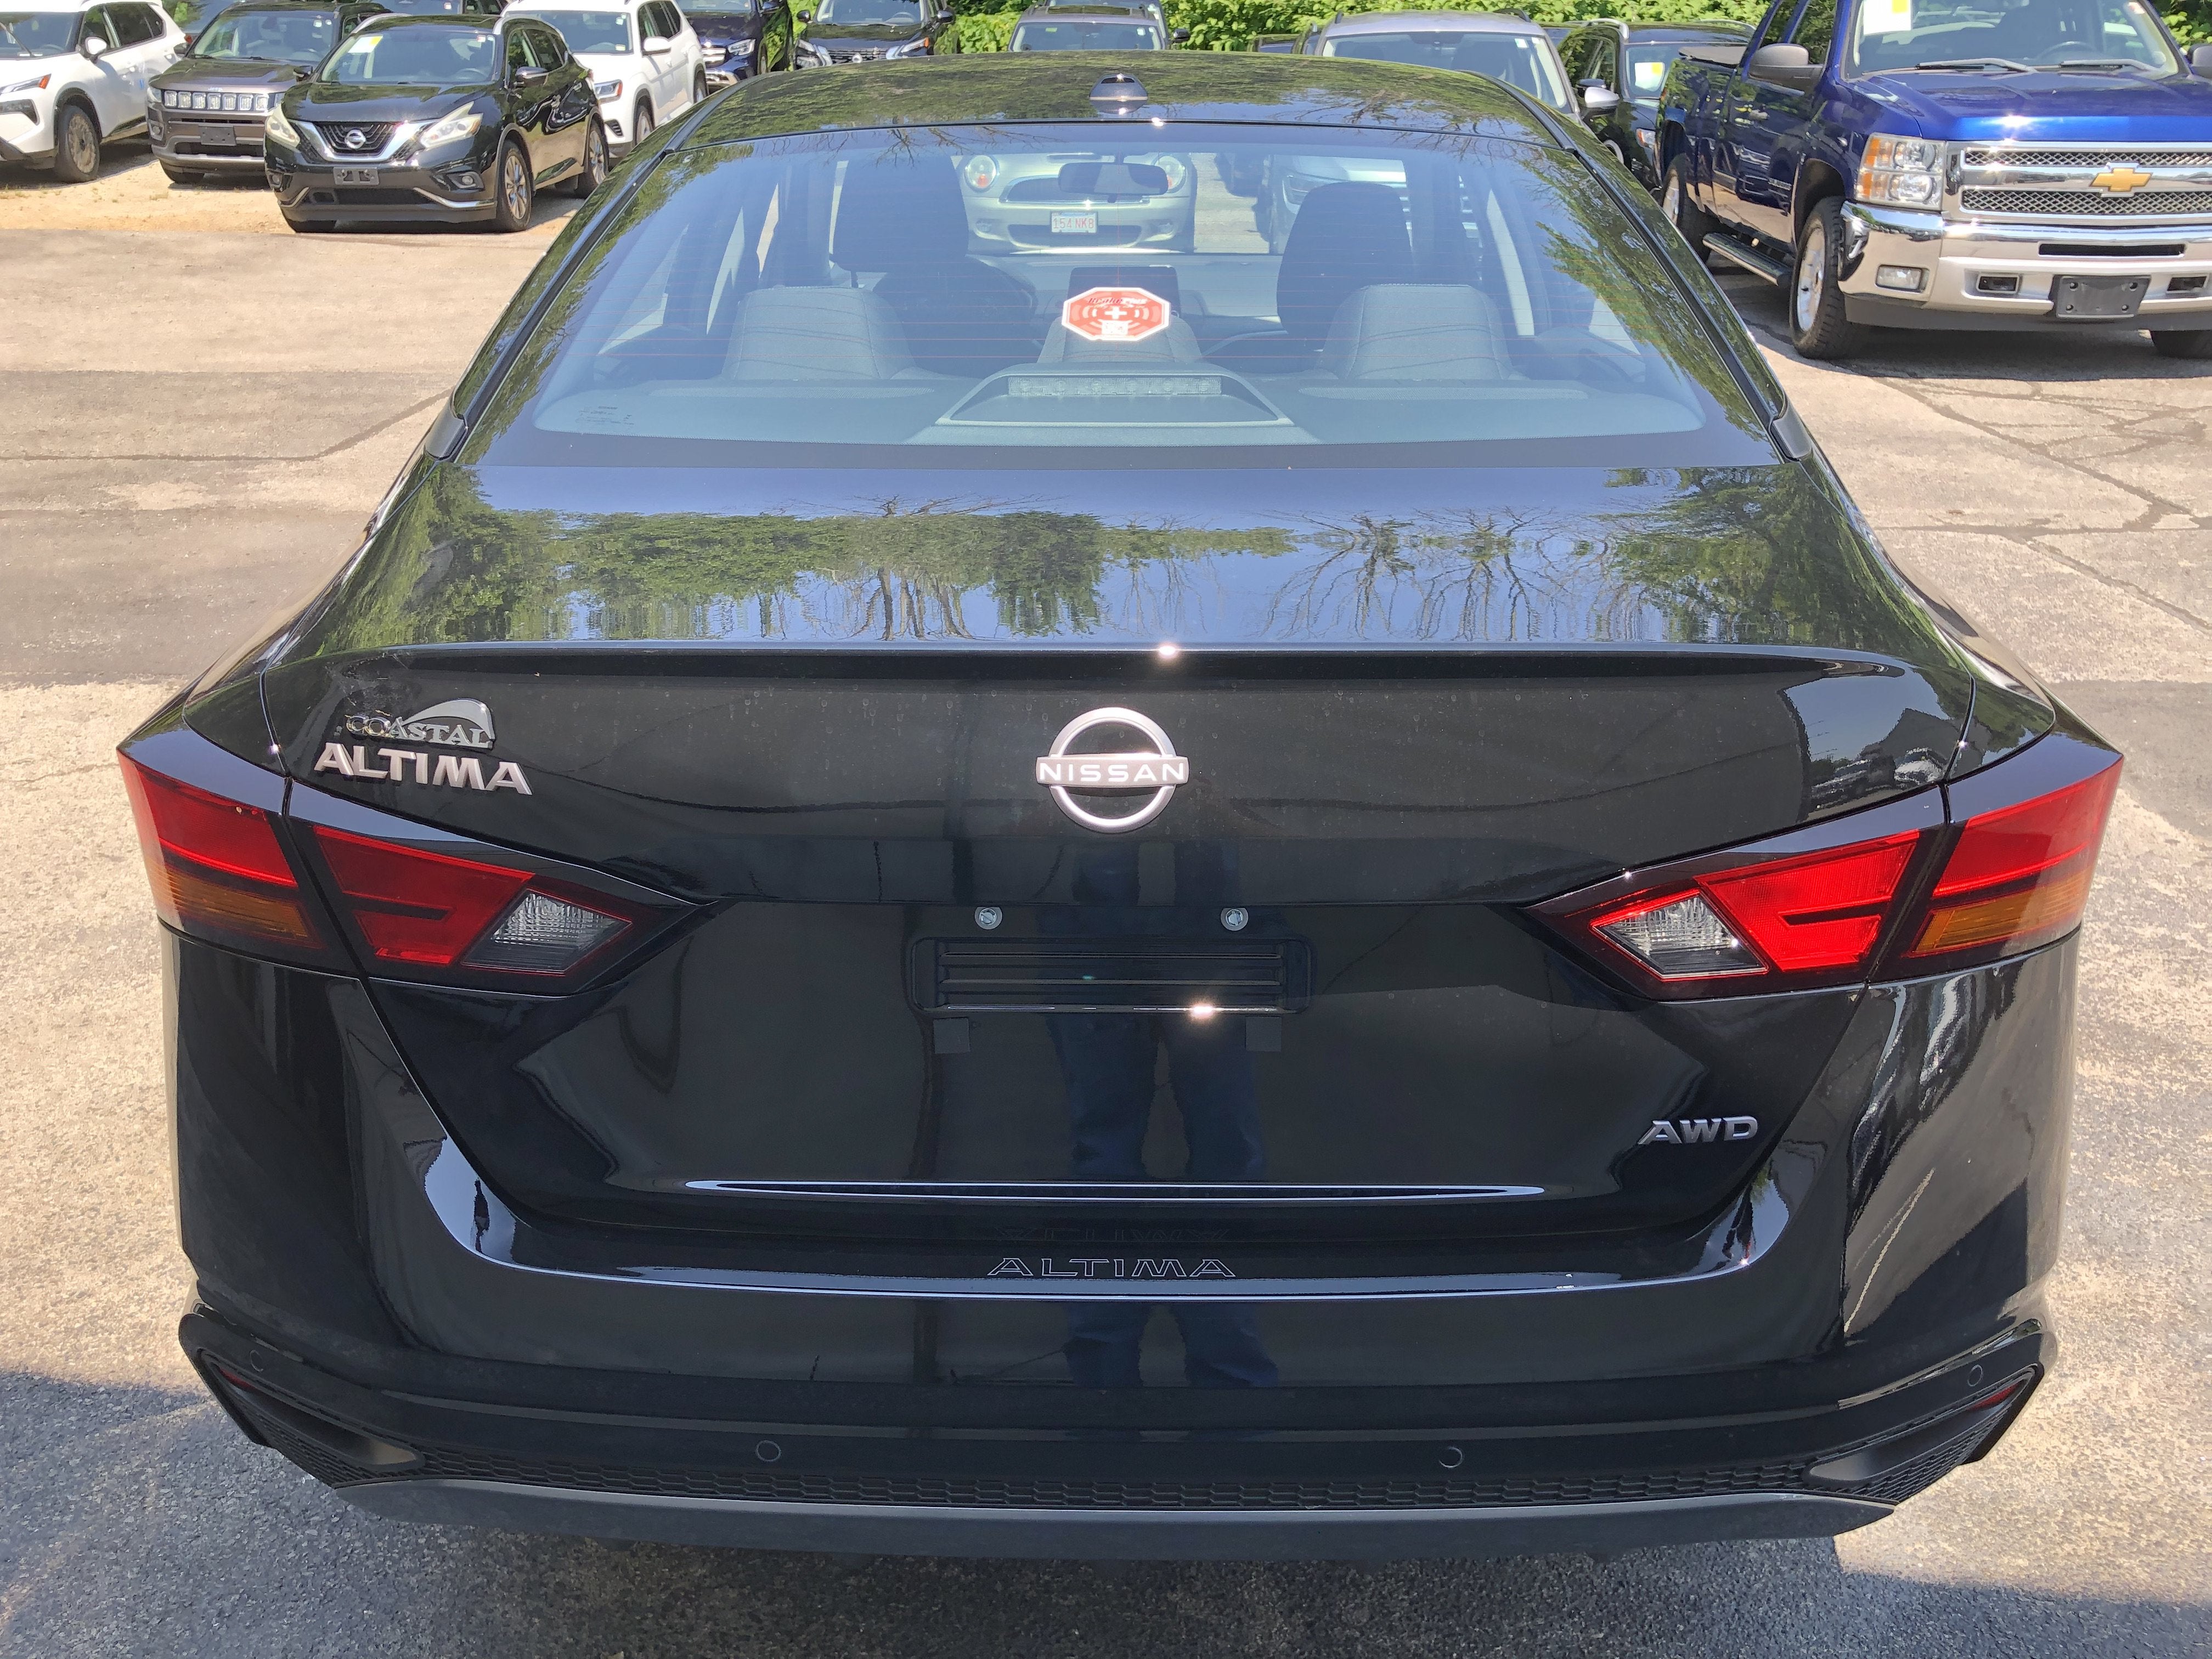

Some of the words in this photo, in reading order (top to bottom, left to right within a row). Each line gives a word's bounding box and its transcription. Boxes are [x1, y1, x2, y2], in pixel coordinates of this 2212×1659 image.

[1053, 218, 1072, 229] 154
[1075, 218, 1094, 229] NK8
[345, 713, 494, 749] COASTAL
[313, 742, 533, 795] ALTIMA
[1039, 762, 1184, 782] NISSAN
[1637, 1115, 1758, 1146] AWD
[987, 1257, 1236, 1277] ALTIMA
